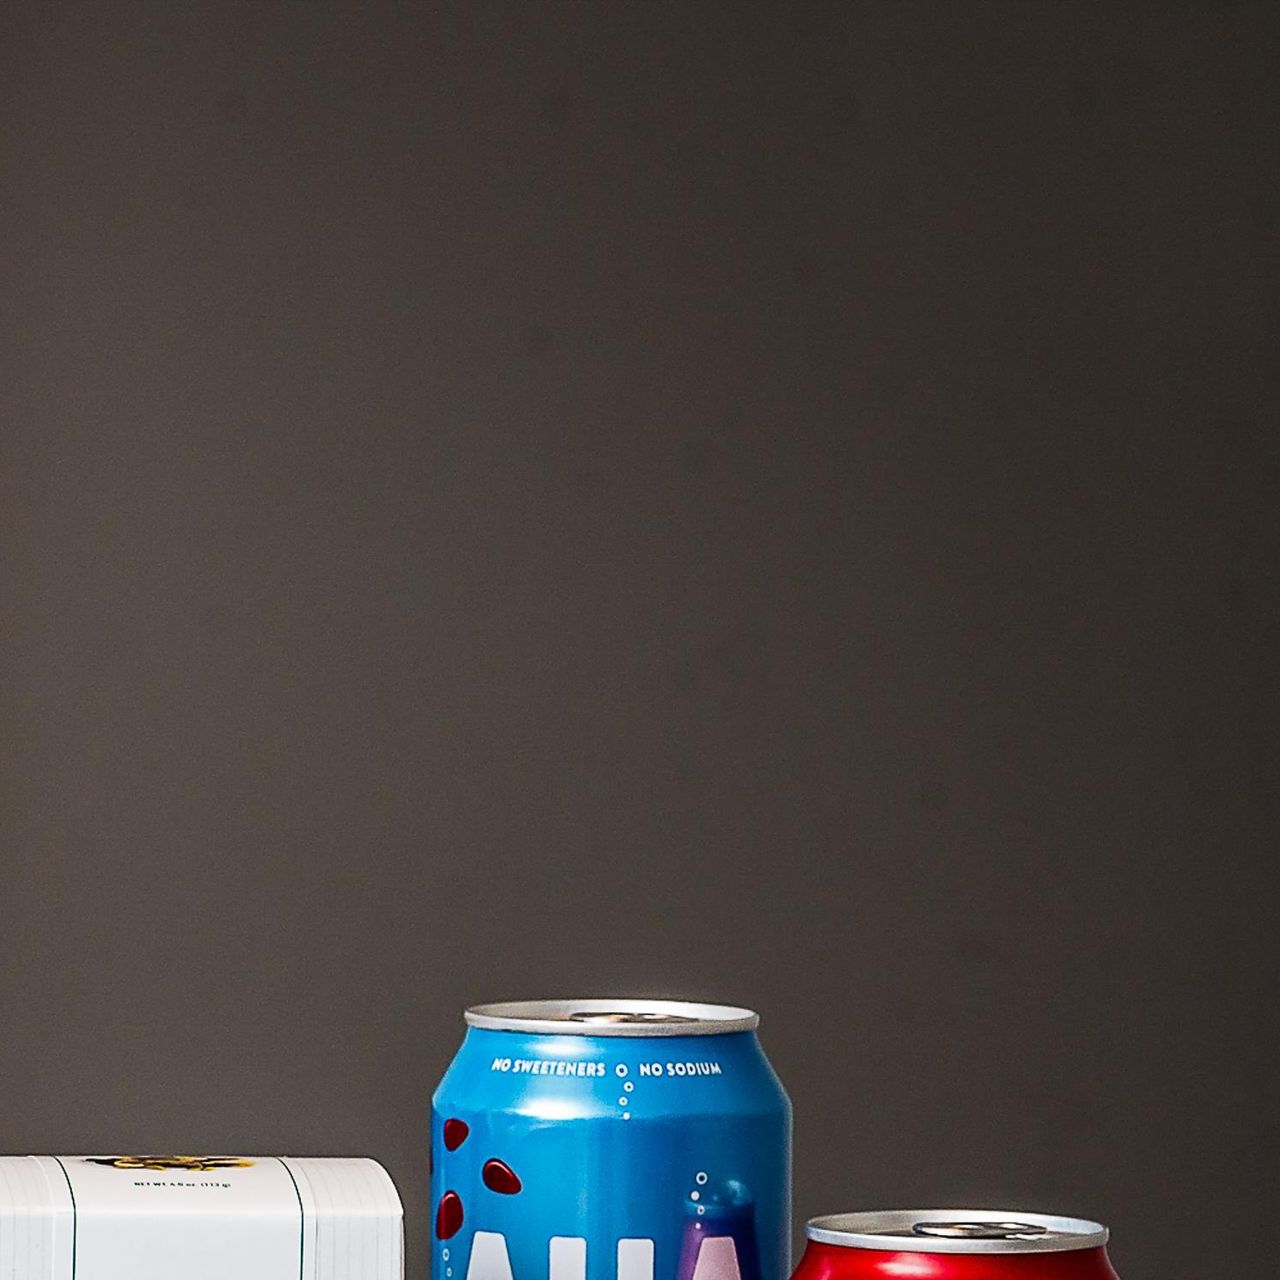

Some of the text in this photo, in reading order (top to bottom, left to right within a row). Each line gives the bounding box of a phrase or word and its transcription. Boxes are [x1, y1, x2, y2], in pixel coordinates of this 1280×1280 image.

[492, 1058, 606, 1077] NO SWEETENERS
[639, 1062, 722, 1077] NO SODIUM
